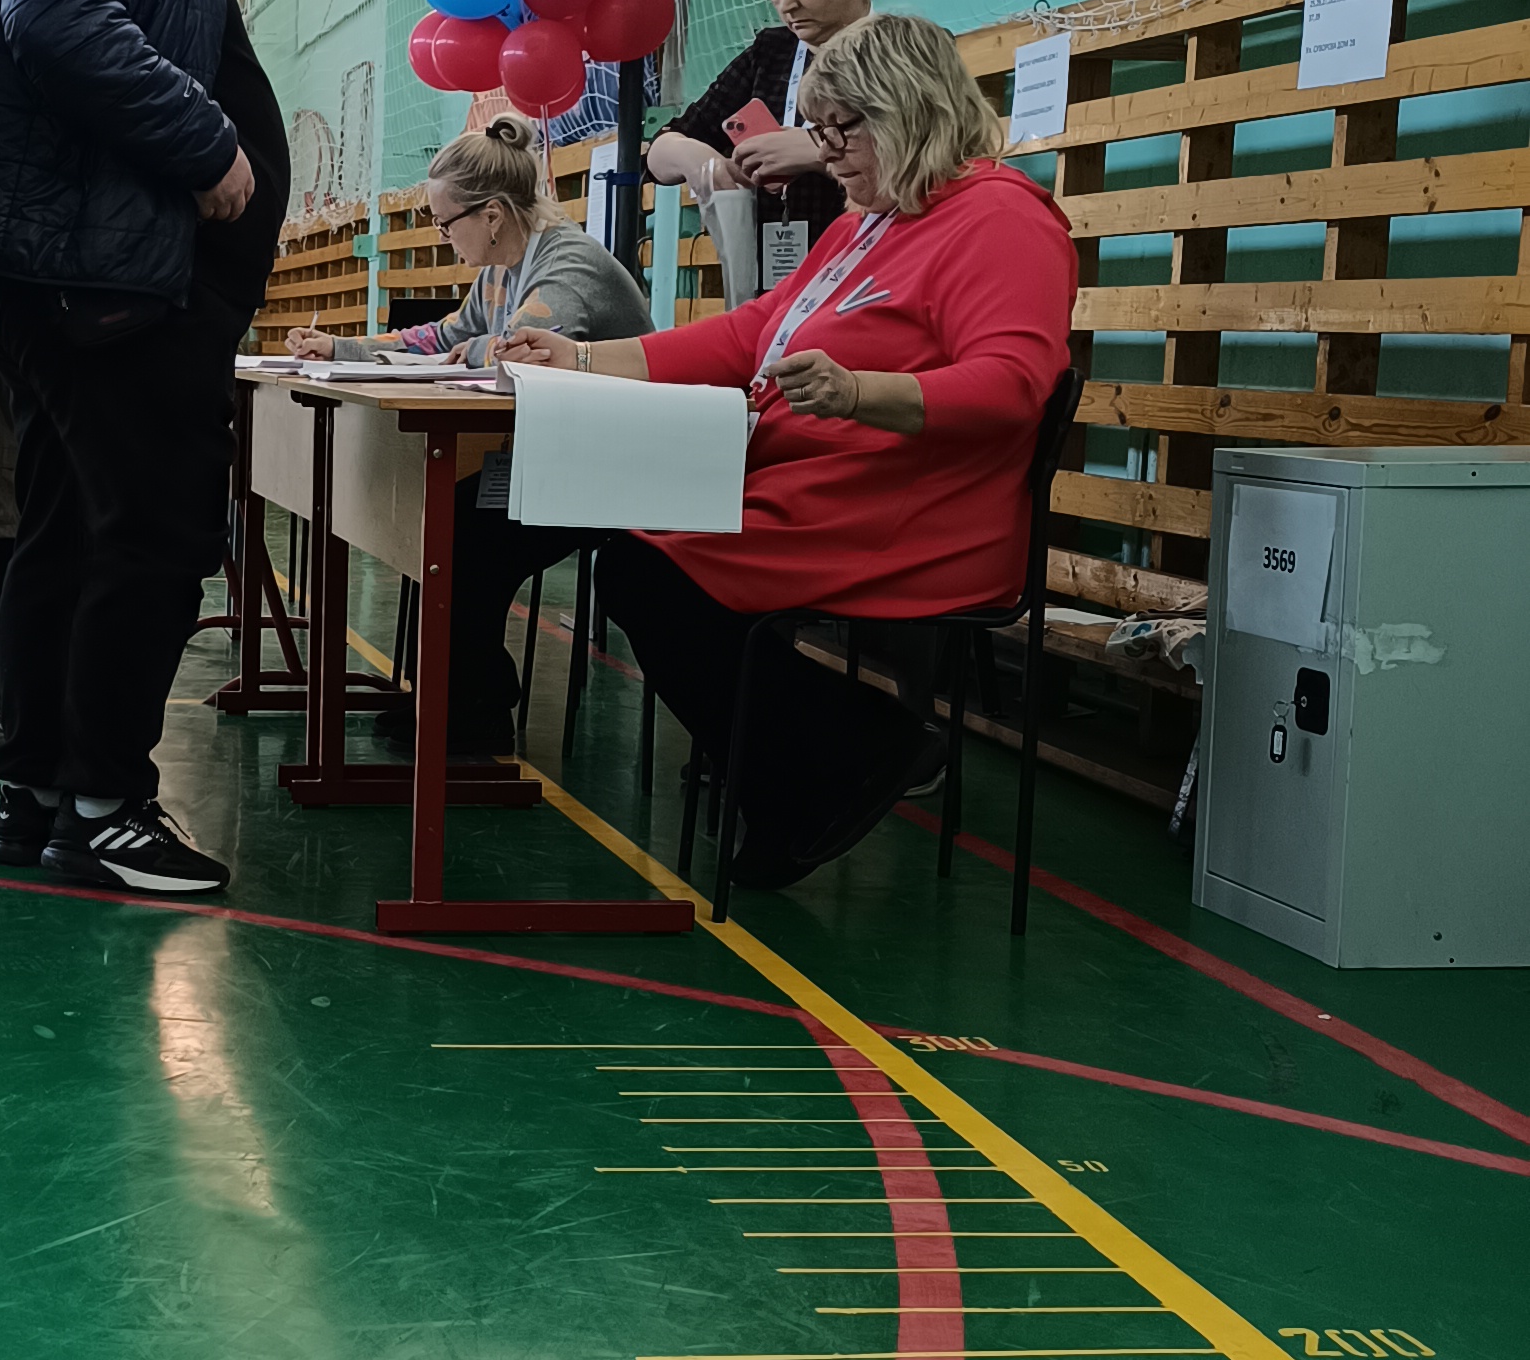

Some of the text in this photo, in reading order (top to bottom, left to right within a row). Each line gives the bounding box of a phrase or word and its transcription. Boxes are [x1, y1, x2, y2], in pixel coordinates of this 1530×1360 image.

[1263, 546, 1296, 574] 3569
[897, 1035, 999, 1052] 300
[1057, 1159, 1110, 1173] 50
[1278, 1327, 1436, 1358] 200
